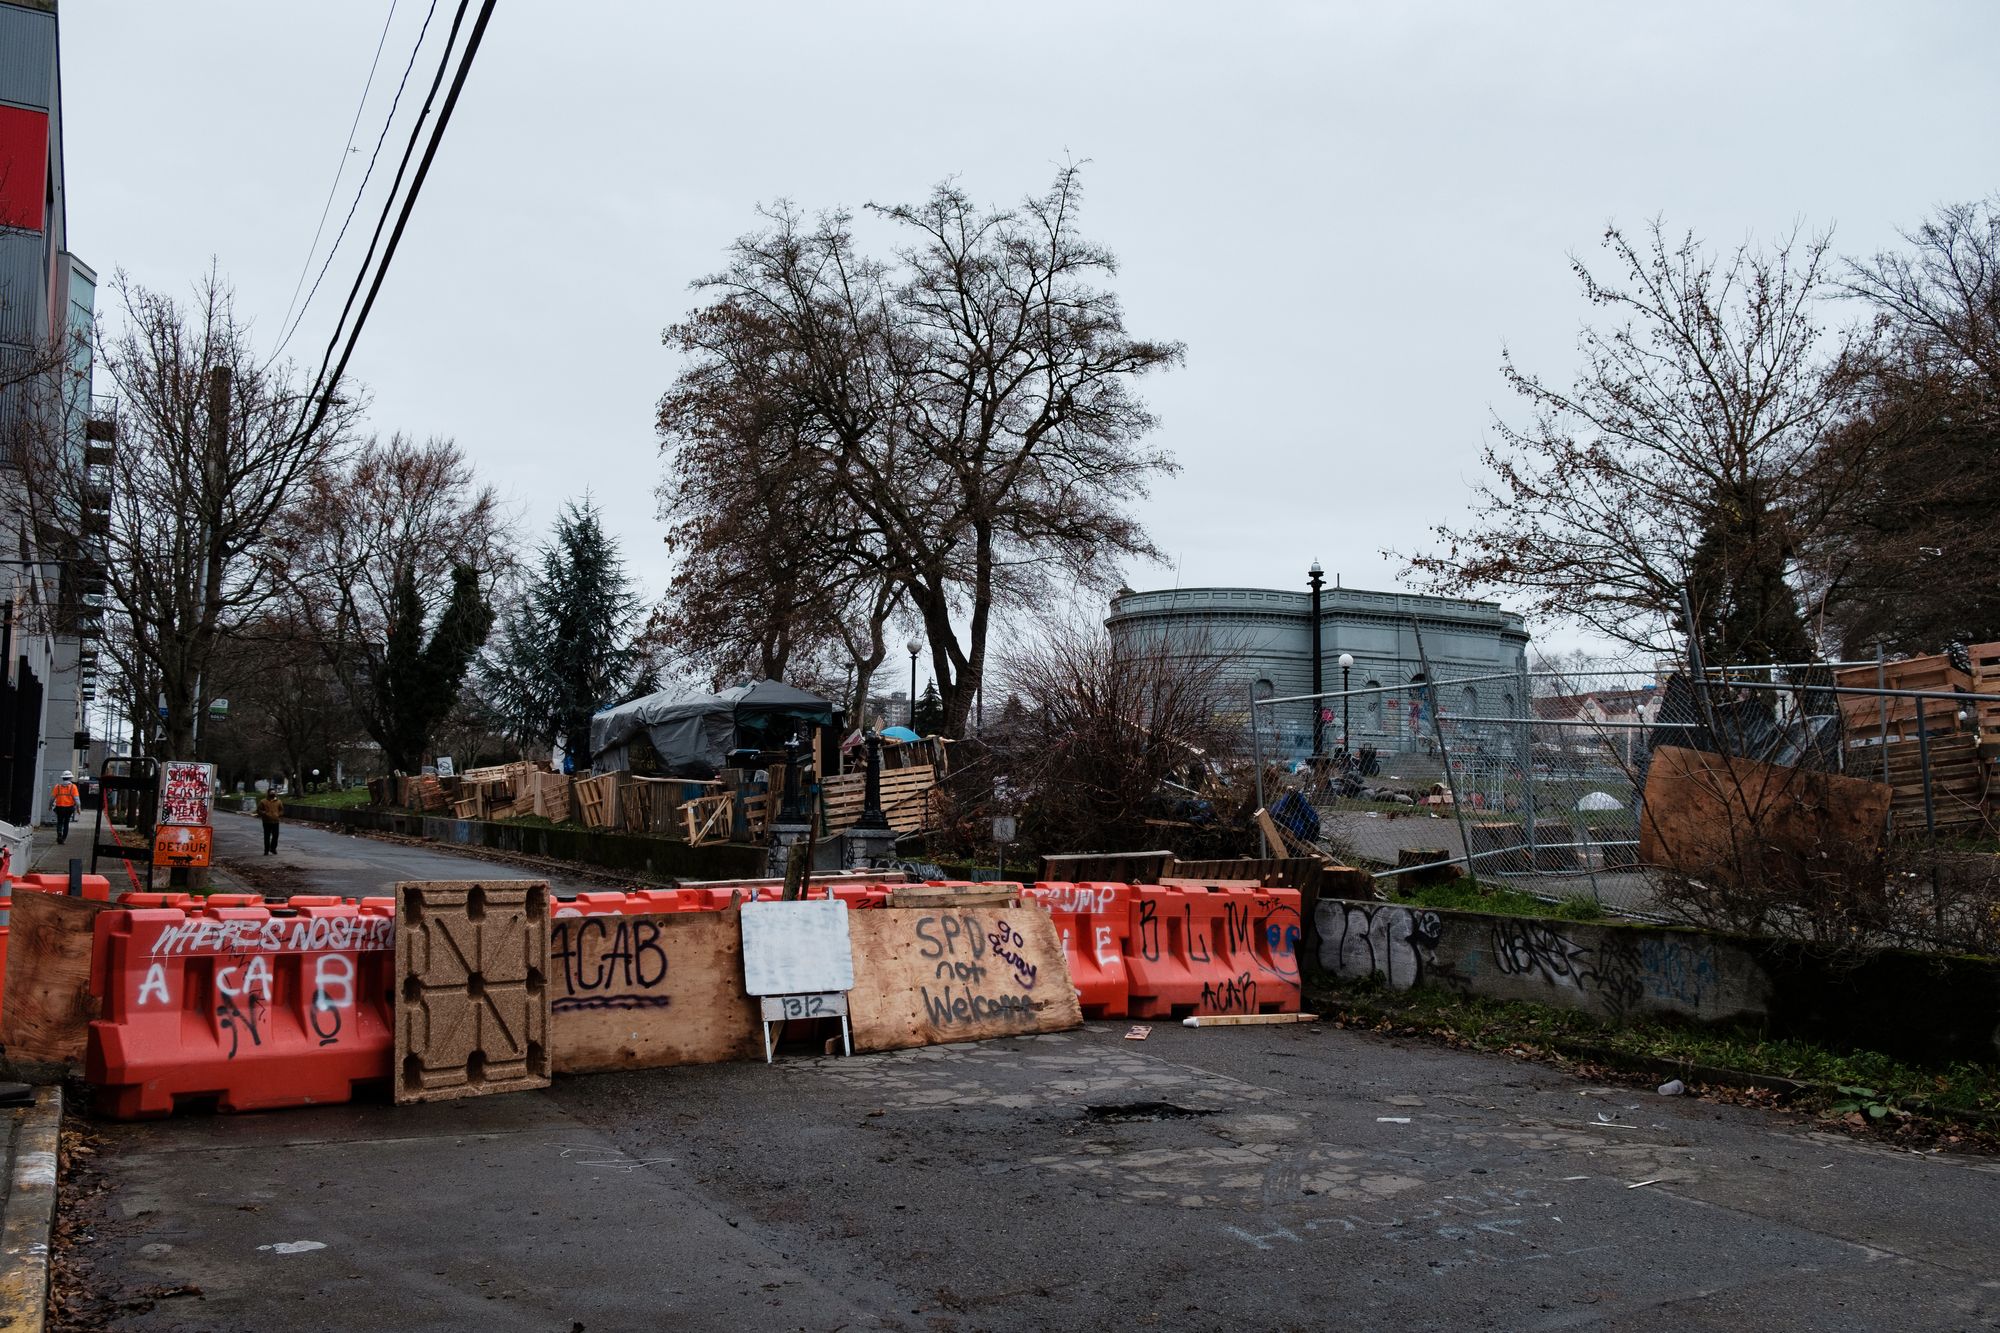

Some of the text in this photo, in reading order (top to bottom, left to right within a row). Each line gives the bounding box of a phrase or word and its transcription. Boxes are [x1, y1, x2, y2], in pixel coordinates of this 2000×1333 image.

[158, 841, 207, 853] DETOUR
[916, 915, 986, 960] SPD
[997, 920, 1024, 948] go
[935, 961, 987, 986] not
[781, 996, 838, 1021] 1312
